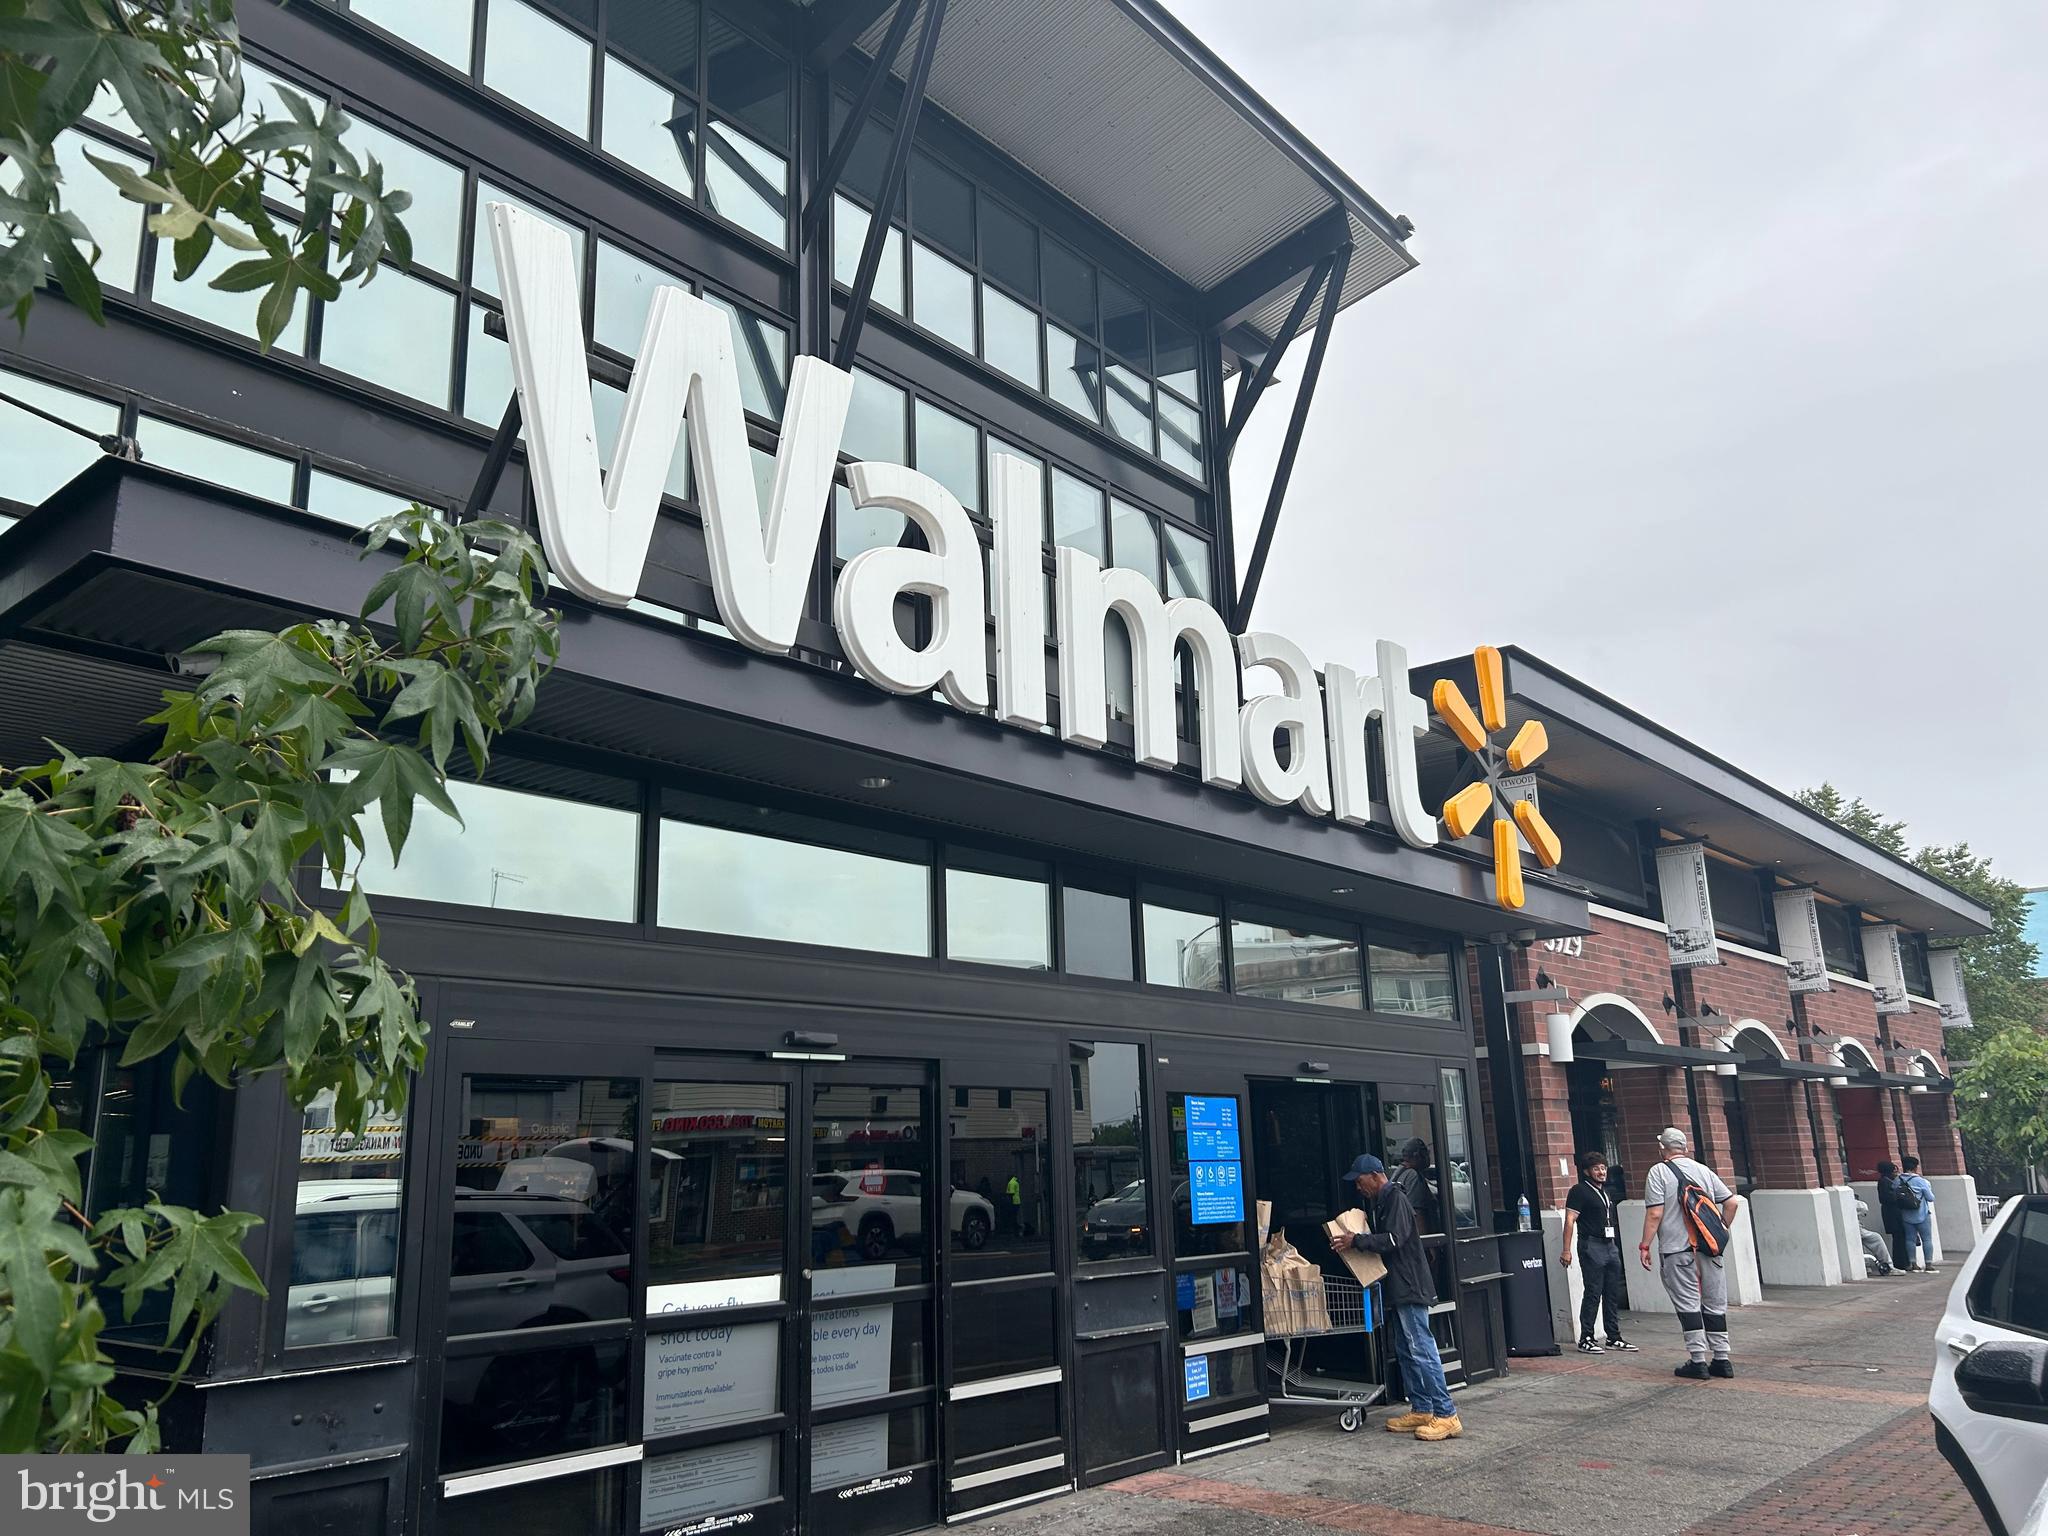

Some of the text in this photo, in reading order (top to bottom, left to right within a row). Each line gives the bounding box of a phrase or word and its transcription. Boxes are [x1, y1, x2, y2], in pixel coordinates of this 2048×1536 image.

[487, 203, 1438, 849] Walmart
[1499, 776, 1533, 788] TWOOD
[1697, 880, 1708, 920] COLORADO
[531, 1123, 569, 1136] Organic
[695, 1327, 734, 1344] today
[831, 1327, 860, 1341] every
[863, 1321, 881, 1337] day
[693, 1351, 715, 1360] contra
[832, 1351, 850, 1360] costo
[658, 1368, 677, 1380] gripe
[677, 1366, 690, 1376] hoy
[656, 1389, 703, 1401] Immunizations
